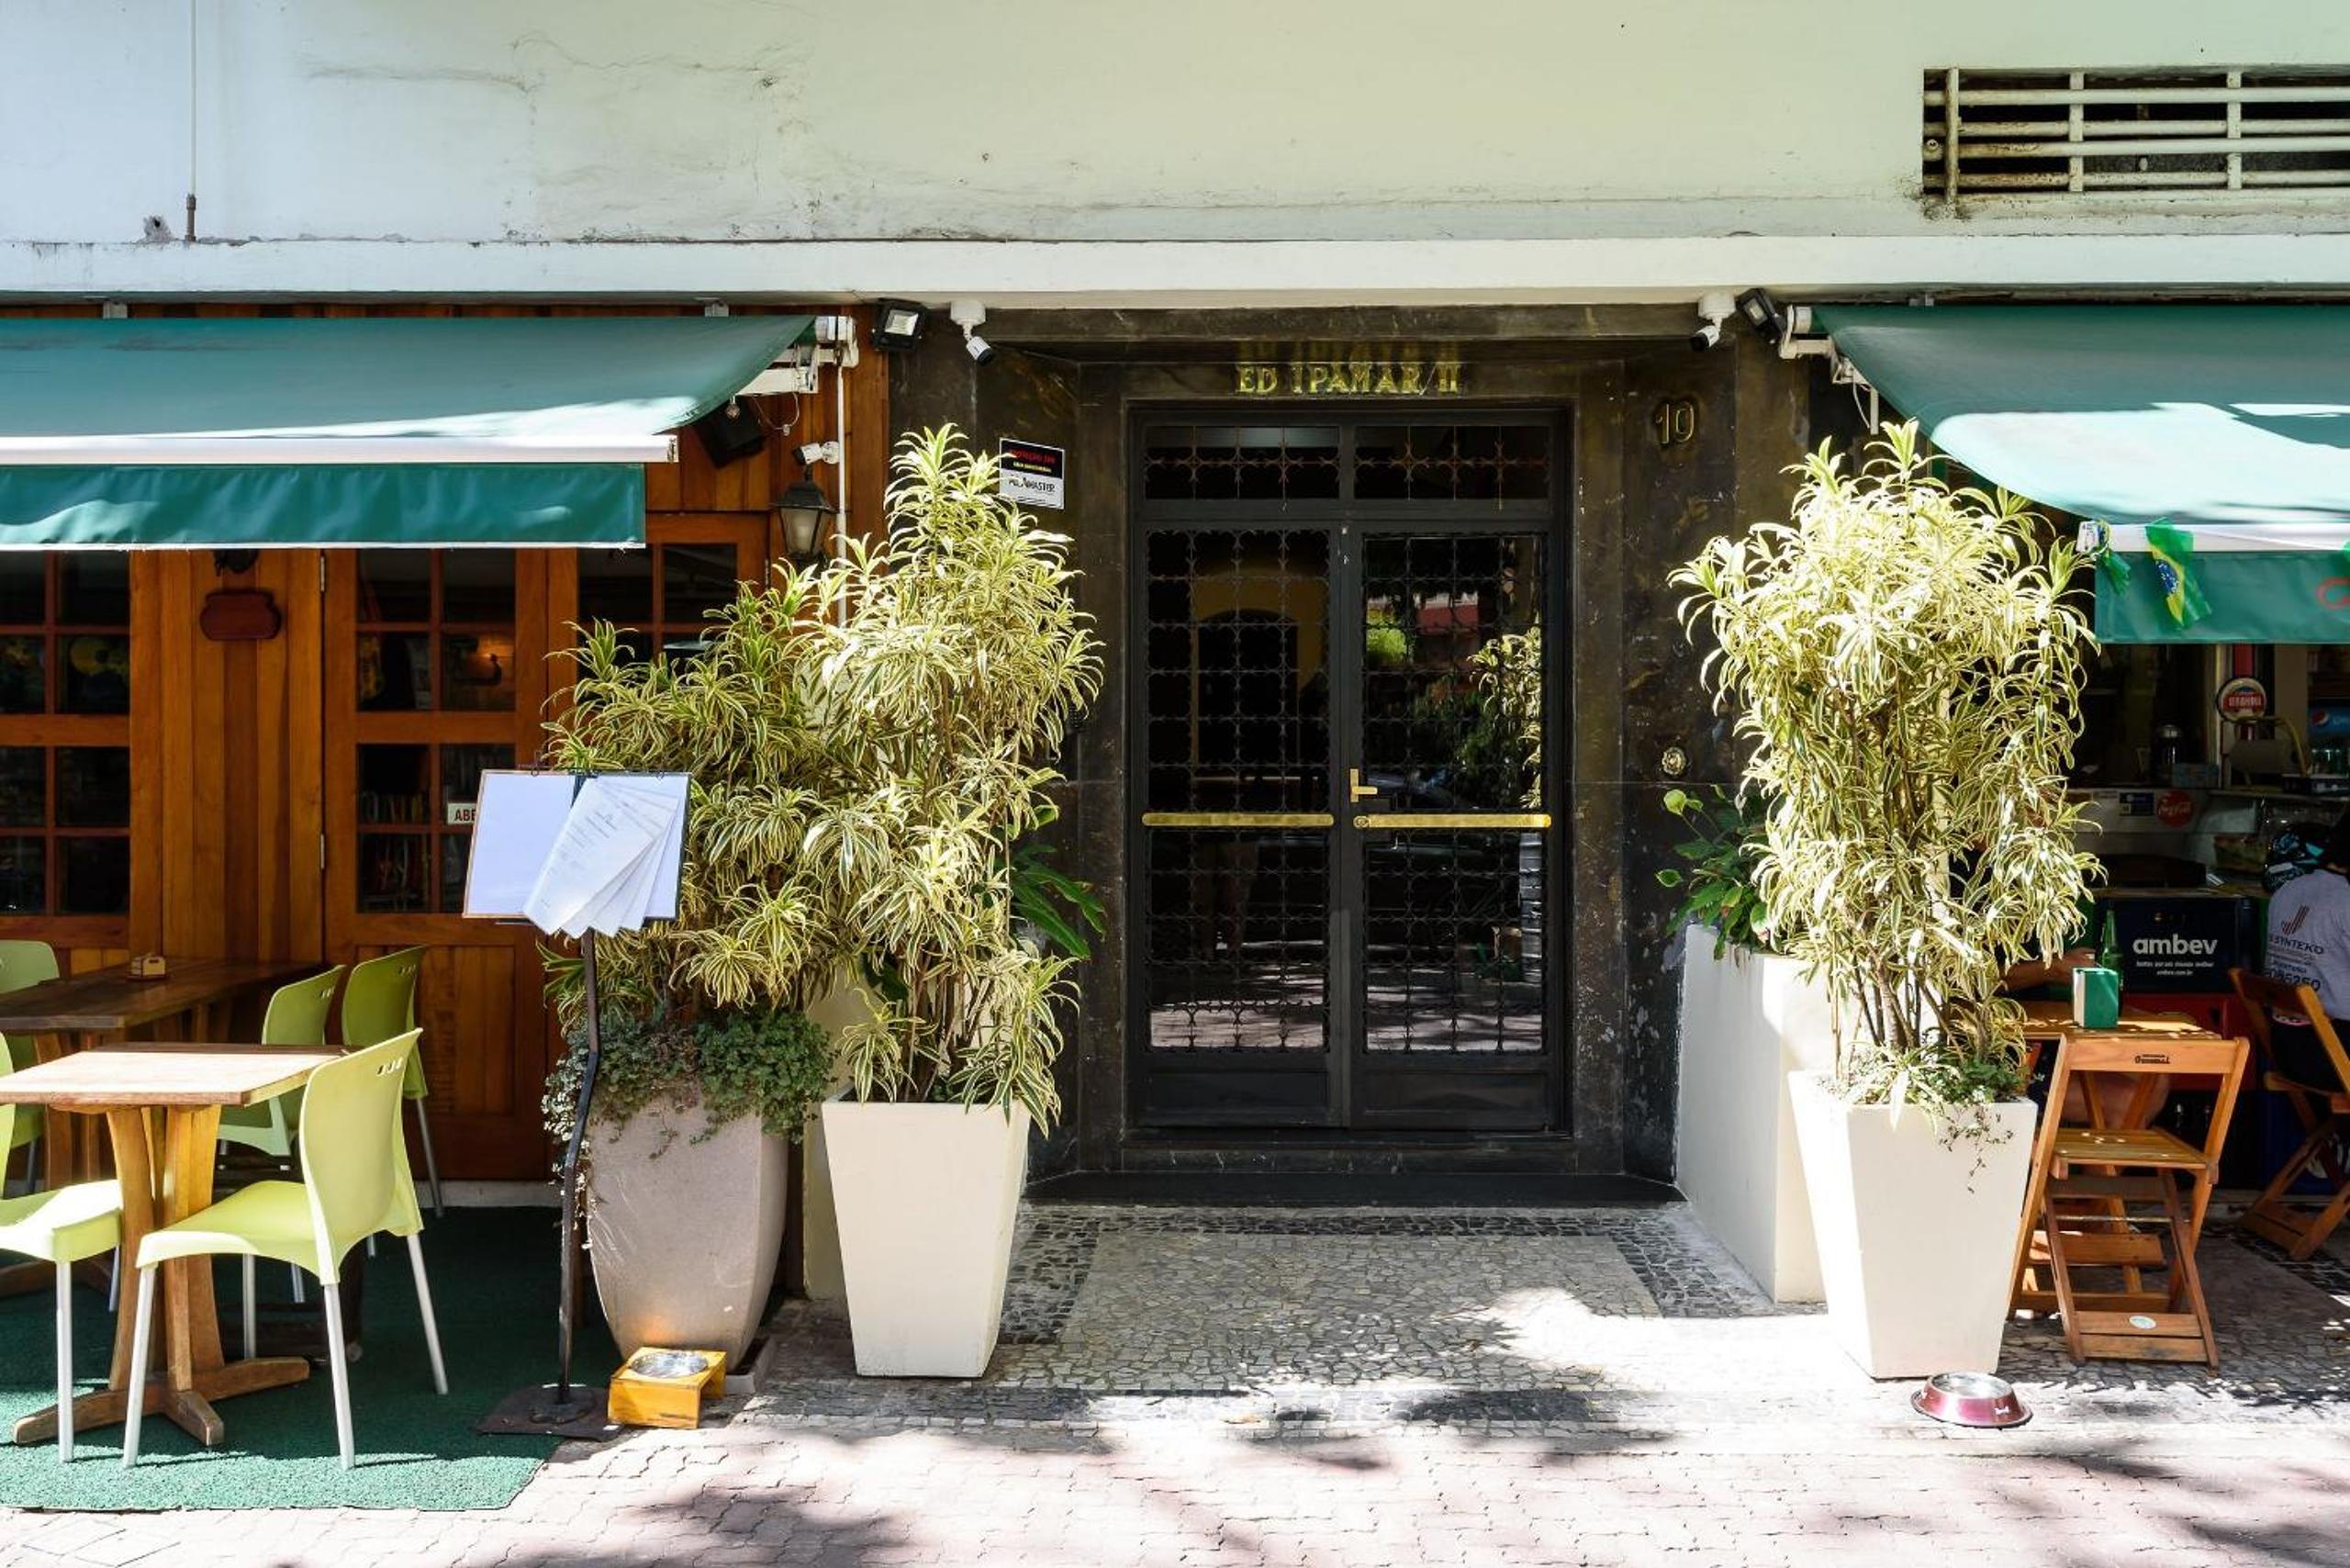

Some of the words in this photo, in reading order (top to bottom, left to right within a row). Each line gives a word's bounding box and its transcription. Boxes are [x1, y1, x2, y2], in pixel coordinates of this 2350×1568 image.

[1236, 363, 1278, 393] ED
[1290, 363, 1421, 394] IPAMAR
[1654, 400, 1695, 443] 10
[2132, 932, 2219, 956] ambev
